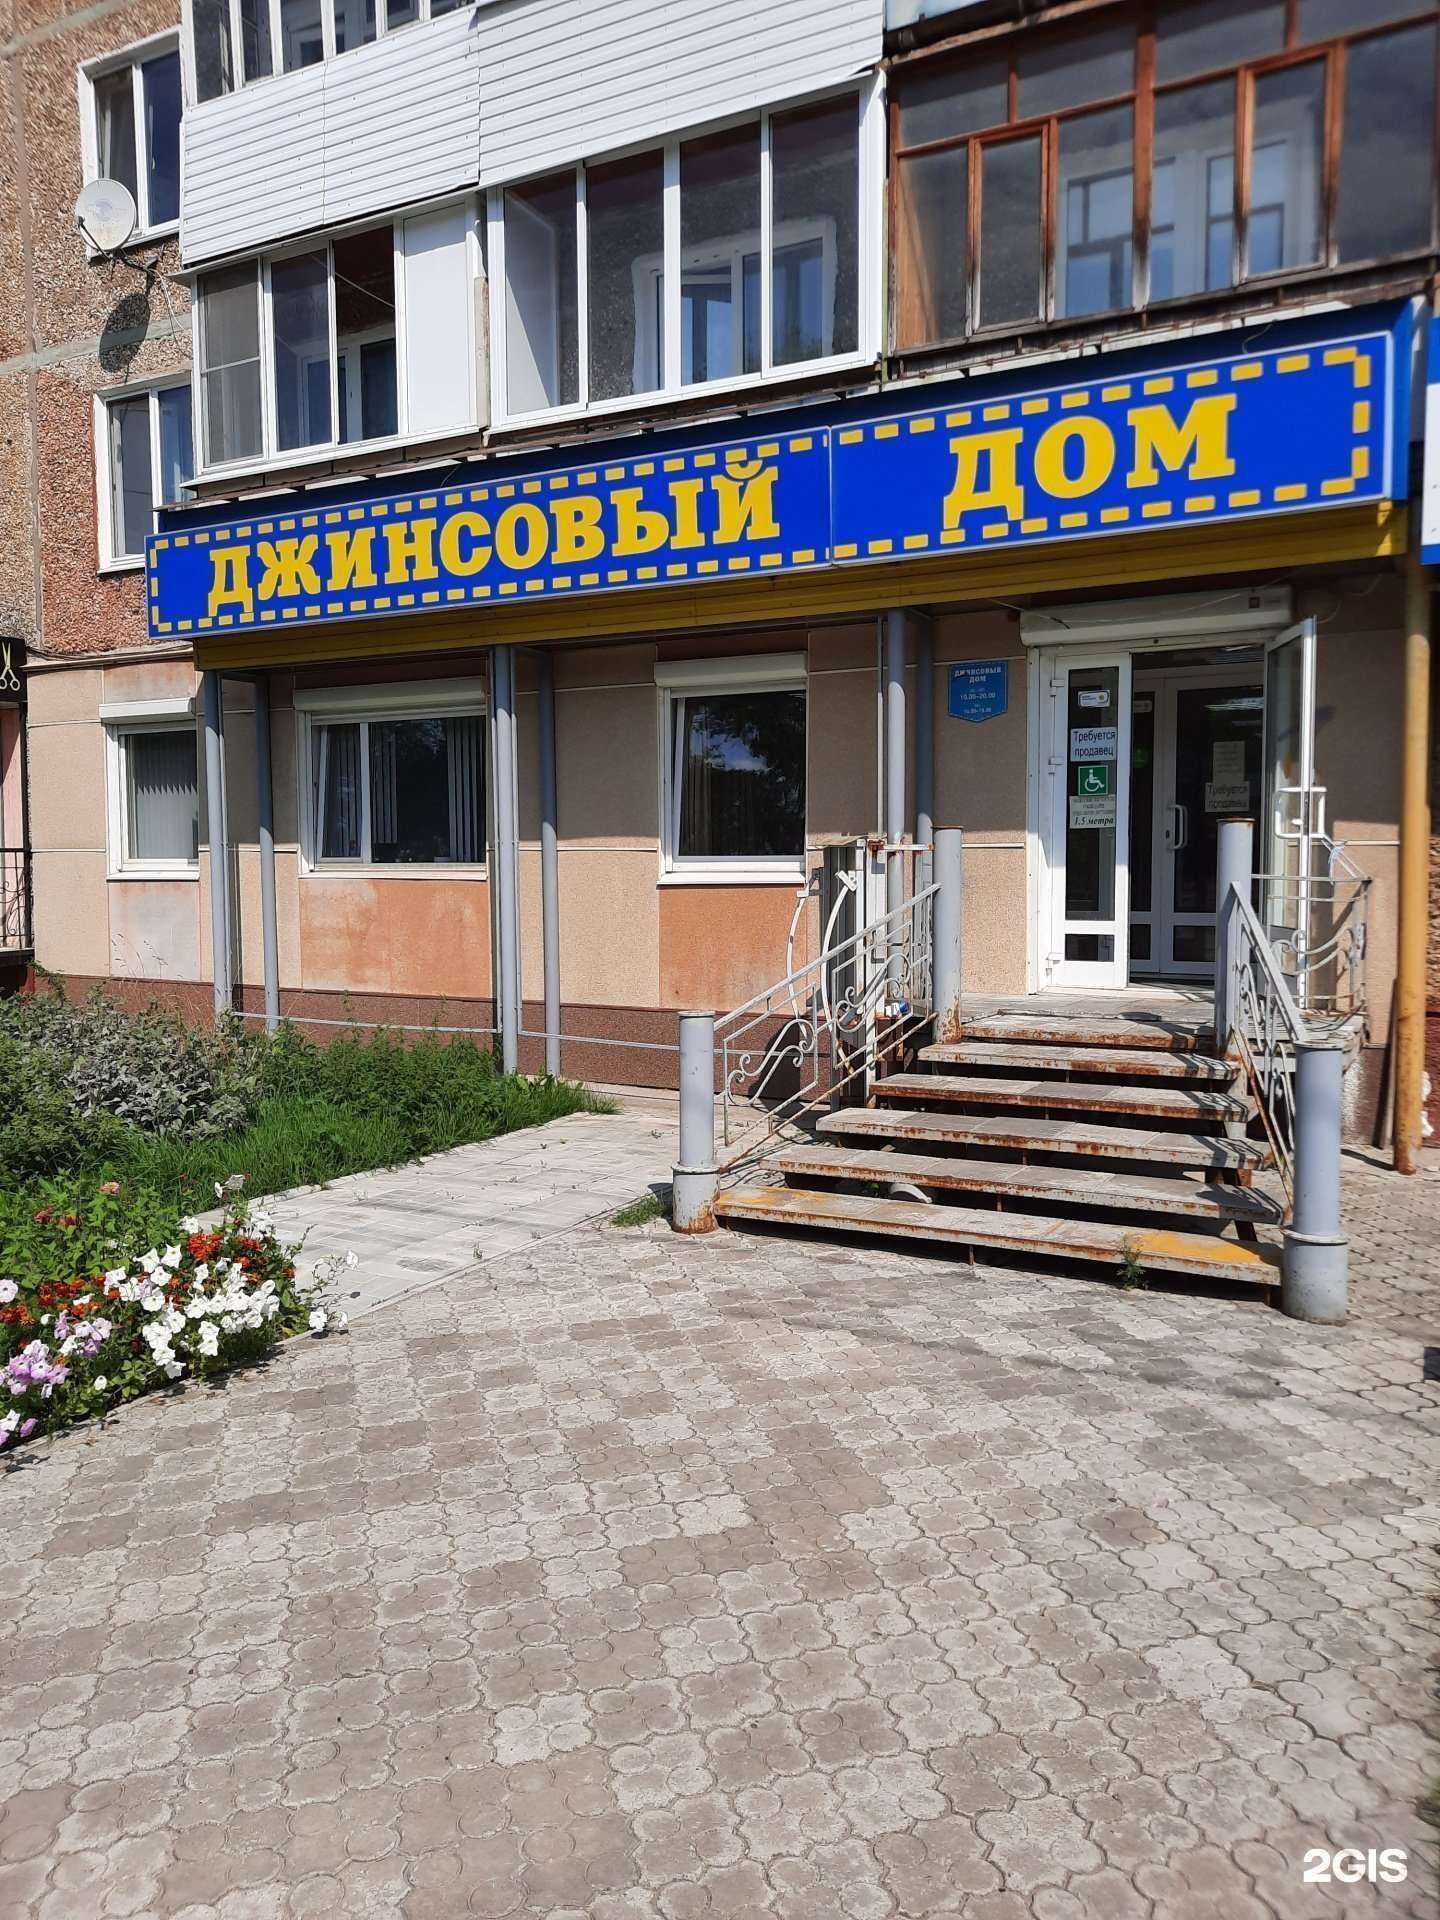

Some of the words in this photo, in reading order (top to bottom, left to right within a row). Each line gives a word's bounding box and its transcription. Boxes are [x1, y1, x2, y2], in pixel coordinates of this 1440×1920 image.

[208, 459, 781, 617] ДЖИНСОВЫЙ
[943, 393, 1237, 529] ДОМ
[969, 675, 987, 684] ДОМ
[1073, 730, 1116, 743] Требуется
[1074, 746, 1114, 758] продавец
